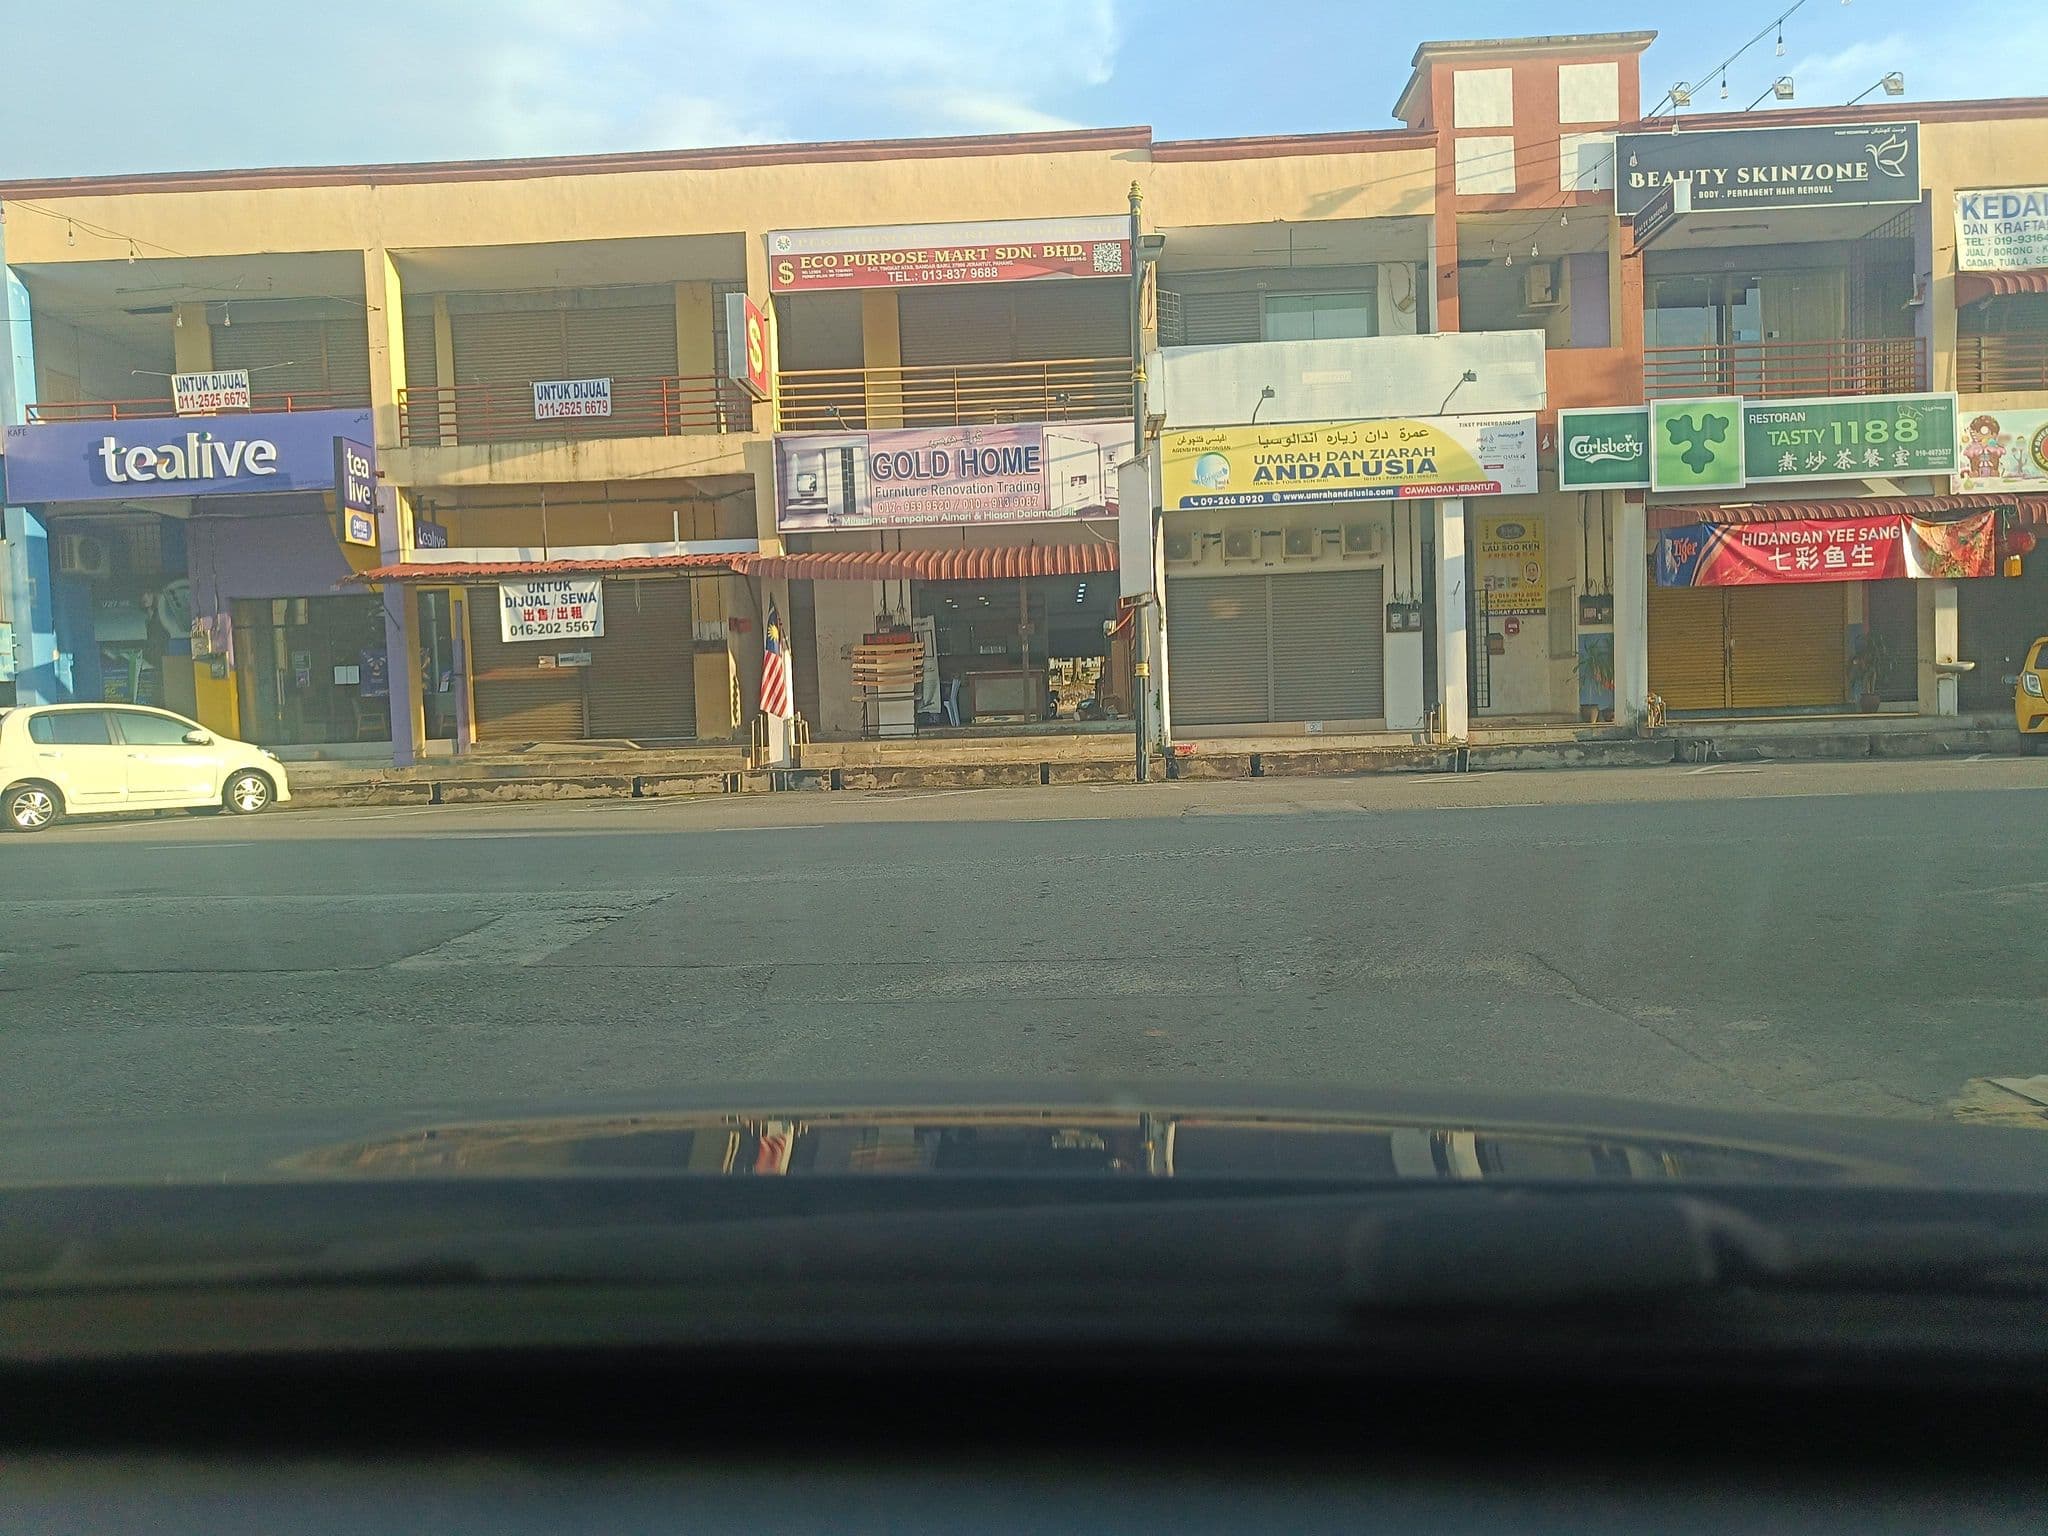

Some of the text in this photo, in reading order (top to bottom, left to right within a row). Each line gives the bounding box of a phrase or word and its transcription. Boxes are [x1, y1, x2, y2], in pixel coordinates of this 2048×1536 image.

[1629, 162, 1868, 188] BEAUTY SKINZONE
[1698, 185, 1834, 199] BODY PERMANENT HAIR REMOVAL
[1963, 219, 2048, 236] DAN KRAFTA
[1965, 237, 1985, 247] TEL
[1994, 245, 2033, 257] BORONG
[800, 244, 1087, 269] ECO PURPOSE MART SDN. BHD.
[922, 268, 967, 281] 013-837
[970, 266, 998, 279] 9688
[175, 373, 246, 392] UNTUK DIJUAL
[536, 382, 608, 400] UNTUK DIJUAL
[178, 391, 248, 408] 011-2525 6679
[538, 400, 608, 416] 011-2525 6679
[1749, 412, 1806, 425] RESTORAN
[7, 428, 28, 437] KAFE
[1767, 418, 1920, 446] TASTY 1188
[98, 431, 277, 483] tealive
[1253, 446, 1436, 465] UMRAH DAN ZIARAH
[1568, 434, 1644, 463] Carlsberg
[346, 447, 370, 480] tea
[871, 445, 1041, 481] GOLD HOME
[1777, 446, 1911, 473] 煮炒茶餐室
[1252, 458, 1438, 482] ANDALUSIA
[347, 475, 371, 505] live
[875, 481, 1041, 499] Furniture Renovation Trading
[1200, 496, 1236, 506] 09-266
[1282, 488, 1394, 500] www.umrahandalusia.com
[1404, 482, 1495, 496] CAWANGAN JERANTUT
[889, 514, 939, 525] Tempahan
[1741, 525, 1900, 547] HIDANGAN YEE SANG
[1674, 537, 1698, 564] Tiger
[1767, 543, 1875, 572] 七彩鱼生
[527, 580, 572, 594] UNTUK
[505, 594, 550, 608] DIJUAL
[560, 592, 597, 605] SEWA
[510, 620, 598, 636] 016-202 5567
